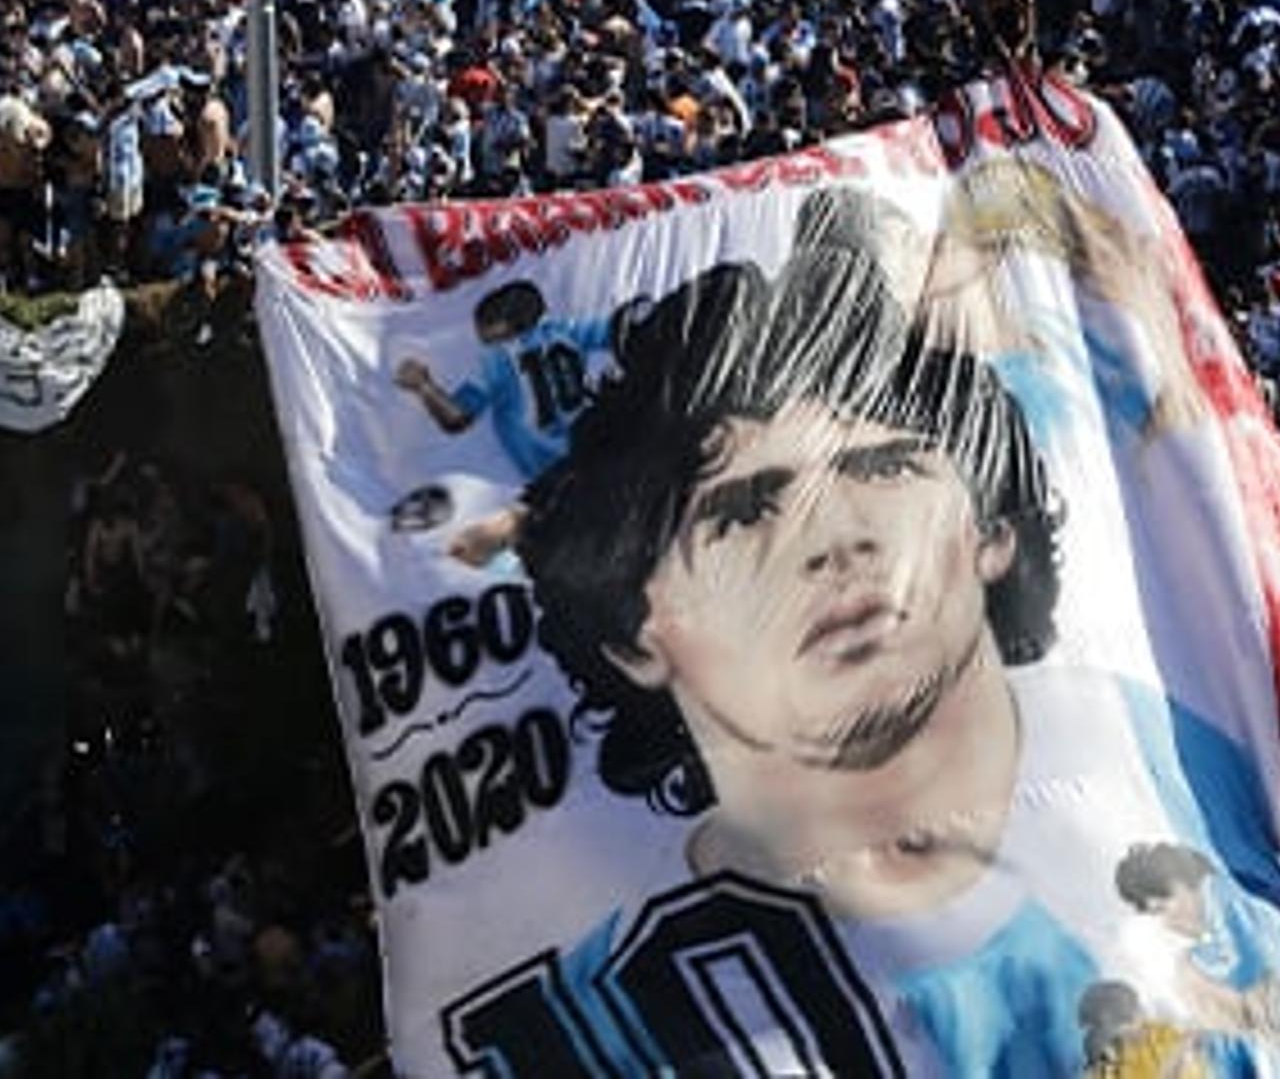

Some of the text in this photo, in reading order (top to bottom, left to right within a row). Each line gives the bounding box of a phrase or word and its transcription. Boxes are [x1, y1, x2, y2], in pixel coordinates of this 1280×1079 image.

[519, 341, 584, 429] 10
[342, 583, 535, 739] 1960
[372, 707, 569, 899] 2020
